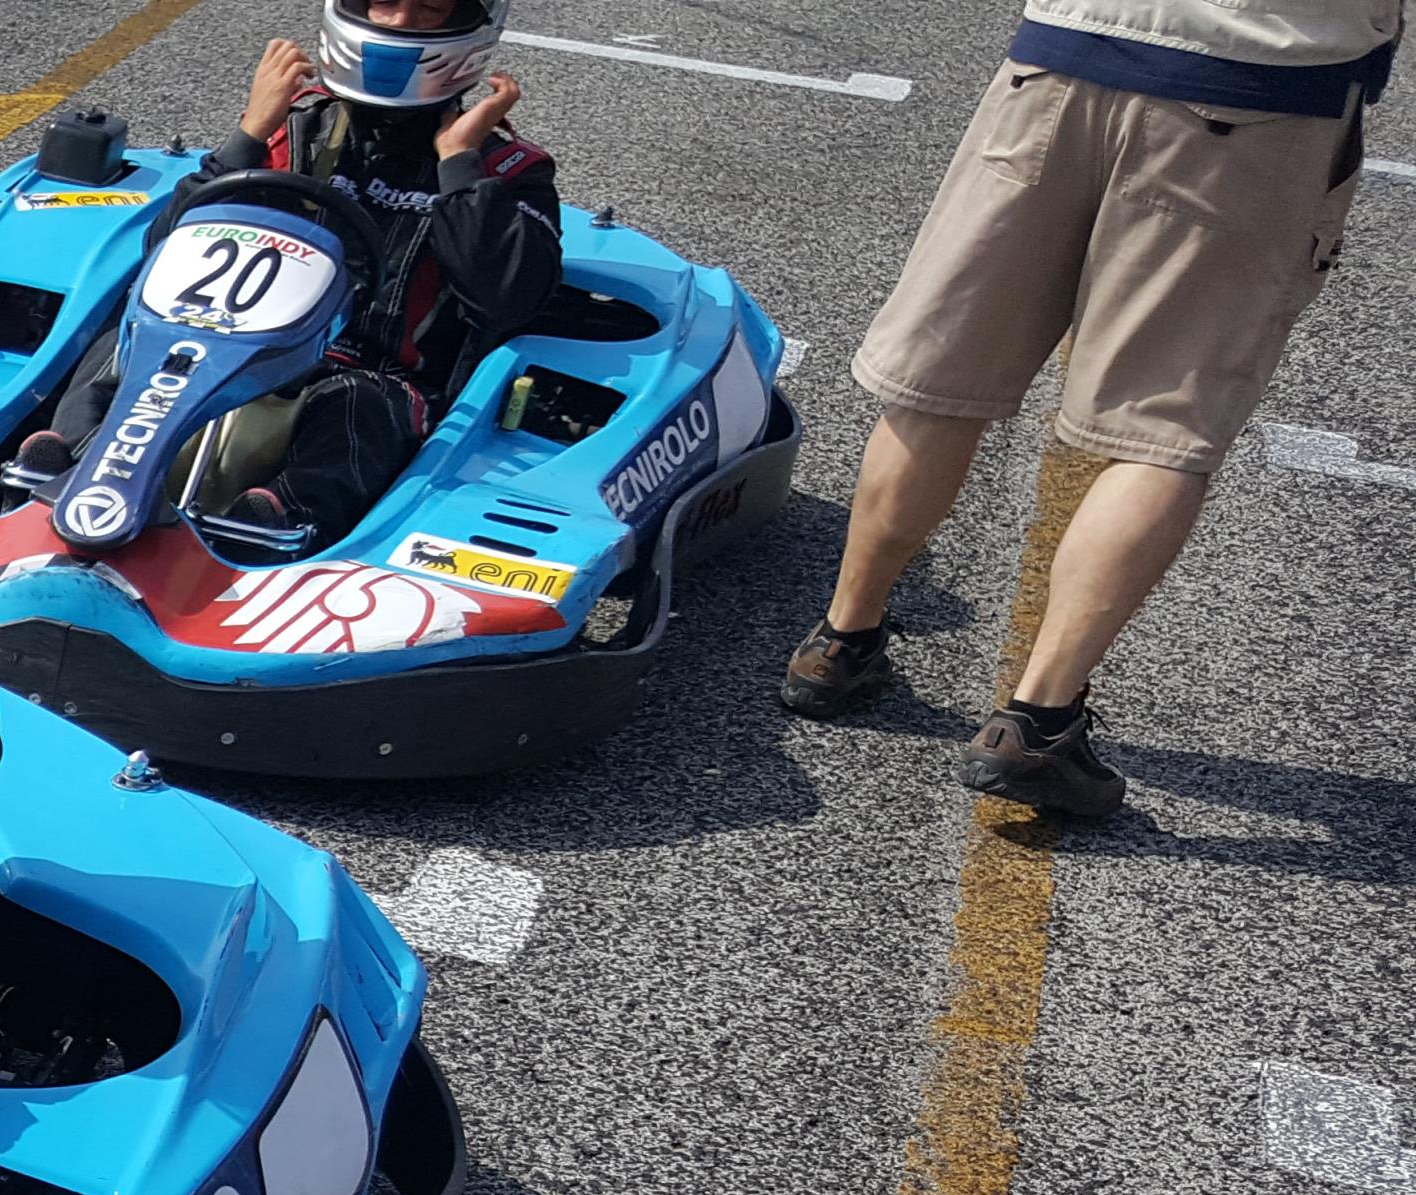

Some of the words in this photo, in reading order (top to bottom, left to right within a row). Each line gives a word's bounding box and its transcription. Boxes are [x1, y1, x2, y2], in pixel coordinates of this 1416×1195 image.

[76, 192, 144, 206] eni
[191, 226, 316, 259] EUROINDY
[175, 238, 282, 314] 20
[91, 341, 207, 481] TECNIROO
[604, 400, 710, 522] ECNIROLO
[469, 562, 562, 596] eni
